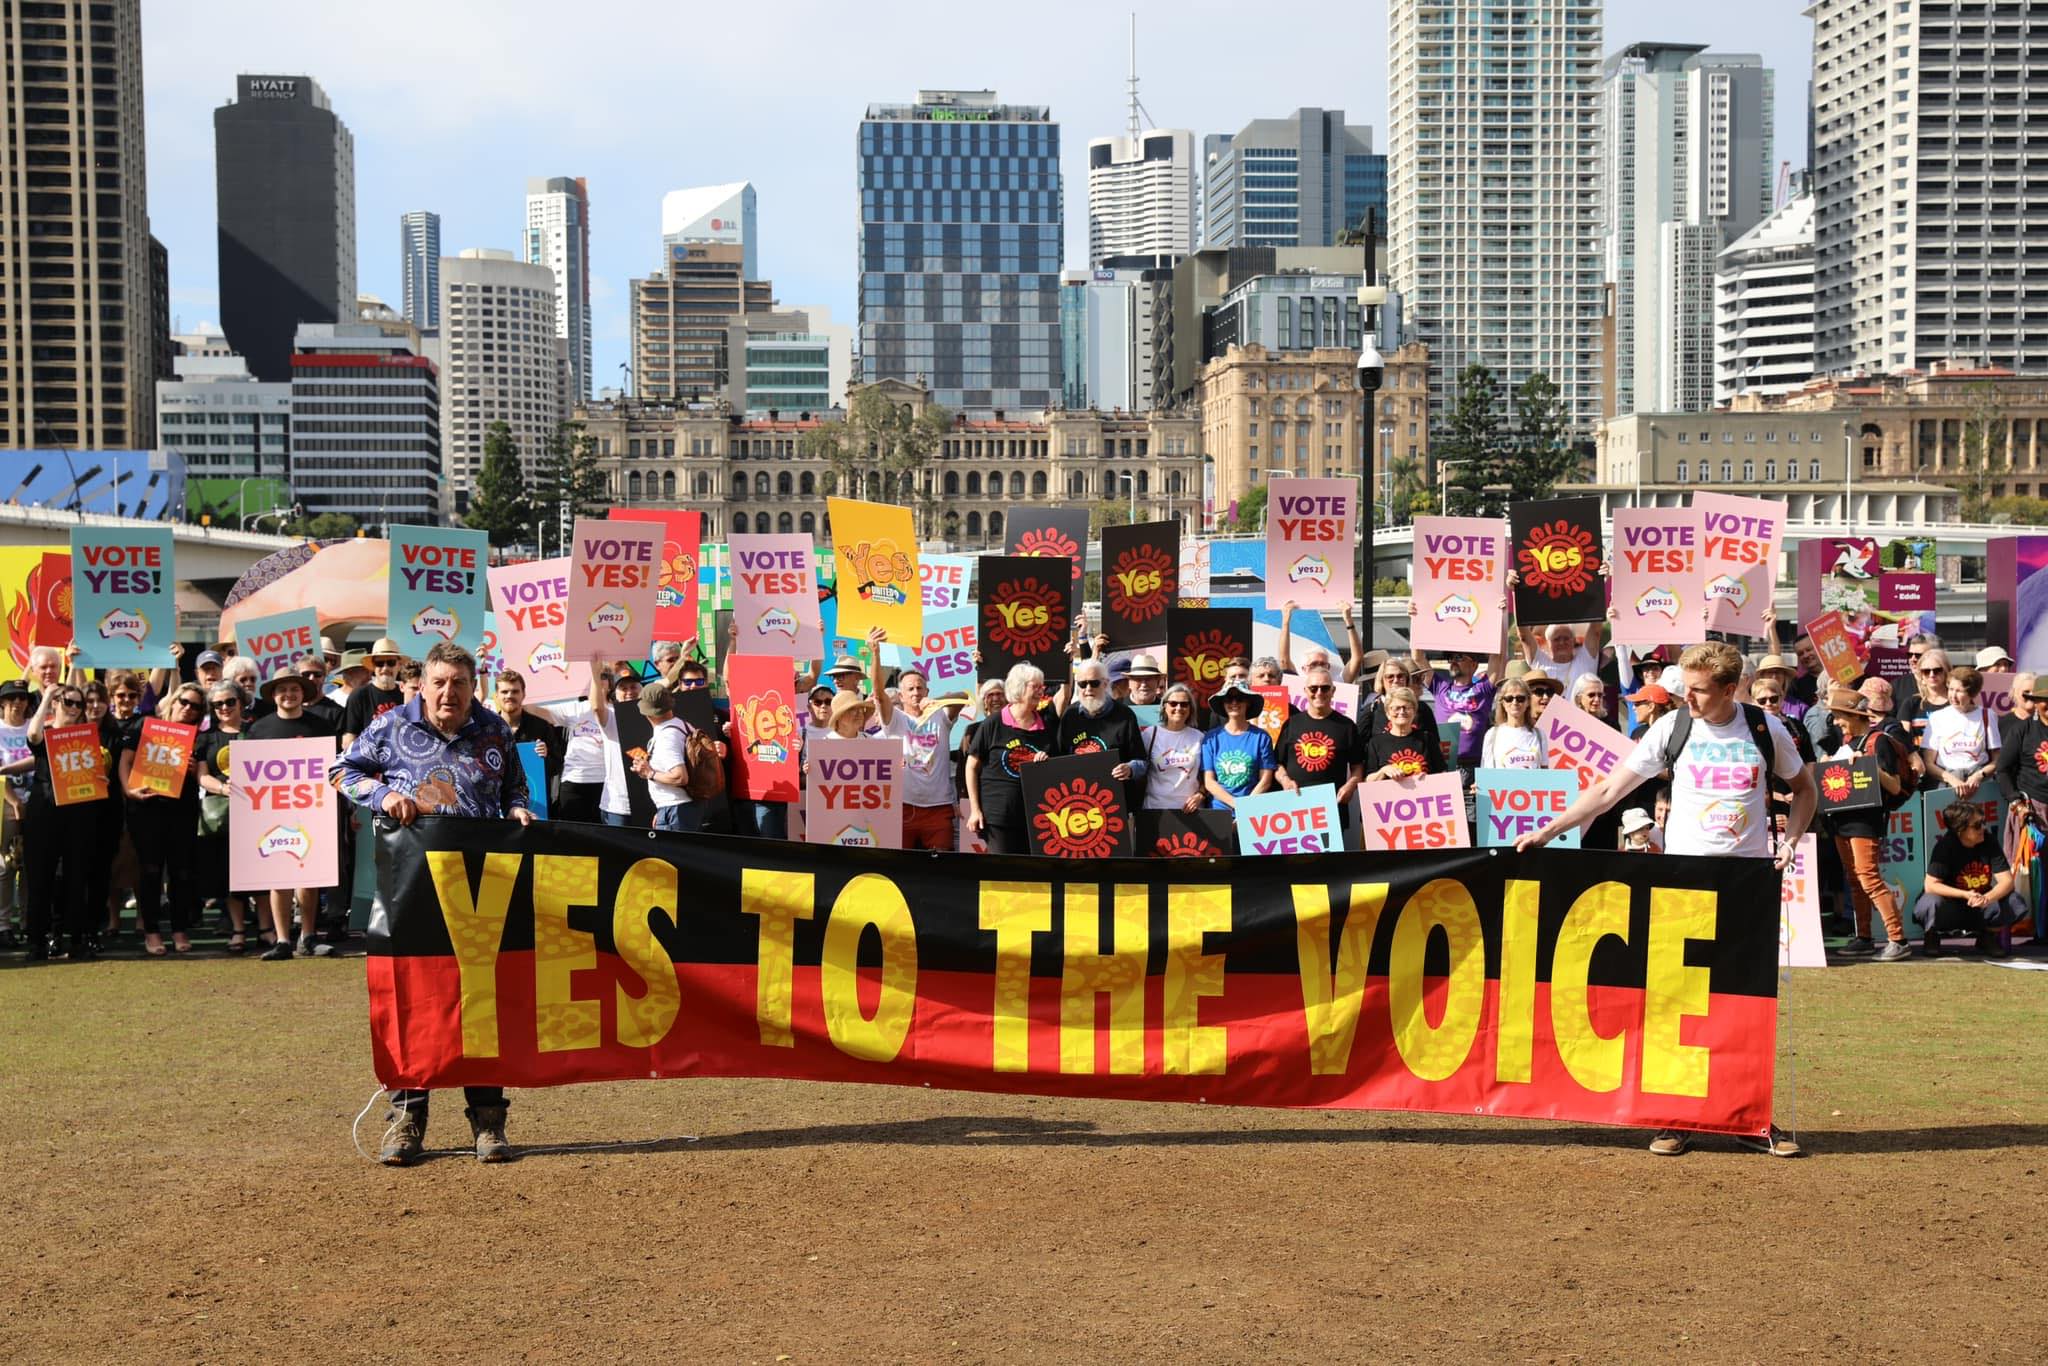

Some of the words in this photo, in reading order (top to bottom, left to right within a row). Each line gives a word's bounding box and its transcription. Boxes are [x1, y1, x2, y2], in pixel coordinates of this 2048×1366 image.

[251, 80, 295, 90] HYATT
[1279, 496, 1345, 516] VOTE
[1278, 519, 1344, 542] YES!
[1624, 526, 1695, 547] VOTE
[1704, 512, 1774, 540] VOTE
[83, 546, 161, 567] VOTE
[402, 543, 477, 569] VOTE
[584, 540, 653, 562] VOTE
[1425, 535, 1495, 556] VOTE
[1704, 536, 1770, 565] YES!
[739, 550, 805, 570] VOTE
[837, 543, 914, 585] Yes
[1298, 565, 1324, 575] yes23
[1424, 556, 1495, 582] YES!
[1529, 544, 1582, 573] Yes
[1623, 550, 1695, 573] YES!
[83, 570, 162, 594] YES!
[400, 568, 475, 595] YES!
[581, 564, 650, 589] YES!
[741, 571, 808, 595] YES!
[918, 564, 963, 585] OTE
[1117, 568, 1163, 598] Yes
[501, 577, 568, 605] VOTE
[921, 586, 960, 608] ES!
[1713, 585, 1742, 595] yes23
[1895, 584, 1921, 592] Family
[1445, 604, 1472, 614] yes23
[1646, 597, 1673, 608] yes23
[110, 619, 140, 630] yes23
[423, 615, 451, 627] yes23
[506, 602, 568, 632] YES
[598, 612, 625, 623] yes23
[765, 616, 791, 627] yes23
[996, 601, 1049, 629] Yes
[248, 626, 313, 656] VOTE
[536, 652, 562, 664] yes23
[1981, 691, 2015, 712] VO
[735, 699, 793, 746] Yes
[144, 742, 183, 767] YES
[1302, 742, 1328, 758] Yes
[1550, 718, 1619, 774] VOTE
[1687, 740, 1760, 763] VOTE
[55, 750, 95, 773] YES
[243, 758, 324, 781] VOTE
[819, 759, 892, 781] VOTE
[1221, 761, 1247, 775] Yes
[1688, 764, 1759, 790] YES!
[1825, 777, 1846, 790] Yes
[243, 784, 324, 811] YES!
[818, 784, 892, 810] YES!
[1374, 794, 1453, 823] VOTE
[1488, 790, 1567, 811] VOTE
[1046, 807, 1104, 838] Yes
[1250, 807, 1328, 836] VOTE
[269, 836, 300, 847] yes23
[1377, 819, 1457, 849] YES!
[1963, 875, 1987, 889] Yes
[426, 851, 682, 1058] YES
[741, 868, 918, 1063] TO
[978, 879, 1233, 1077] THE
[1291, 878, 1718, 1098] VOICE
